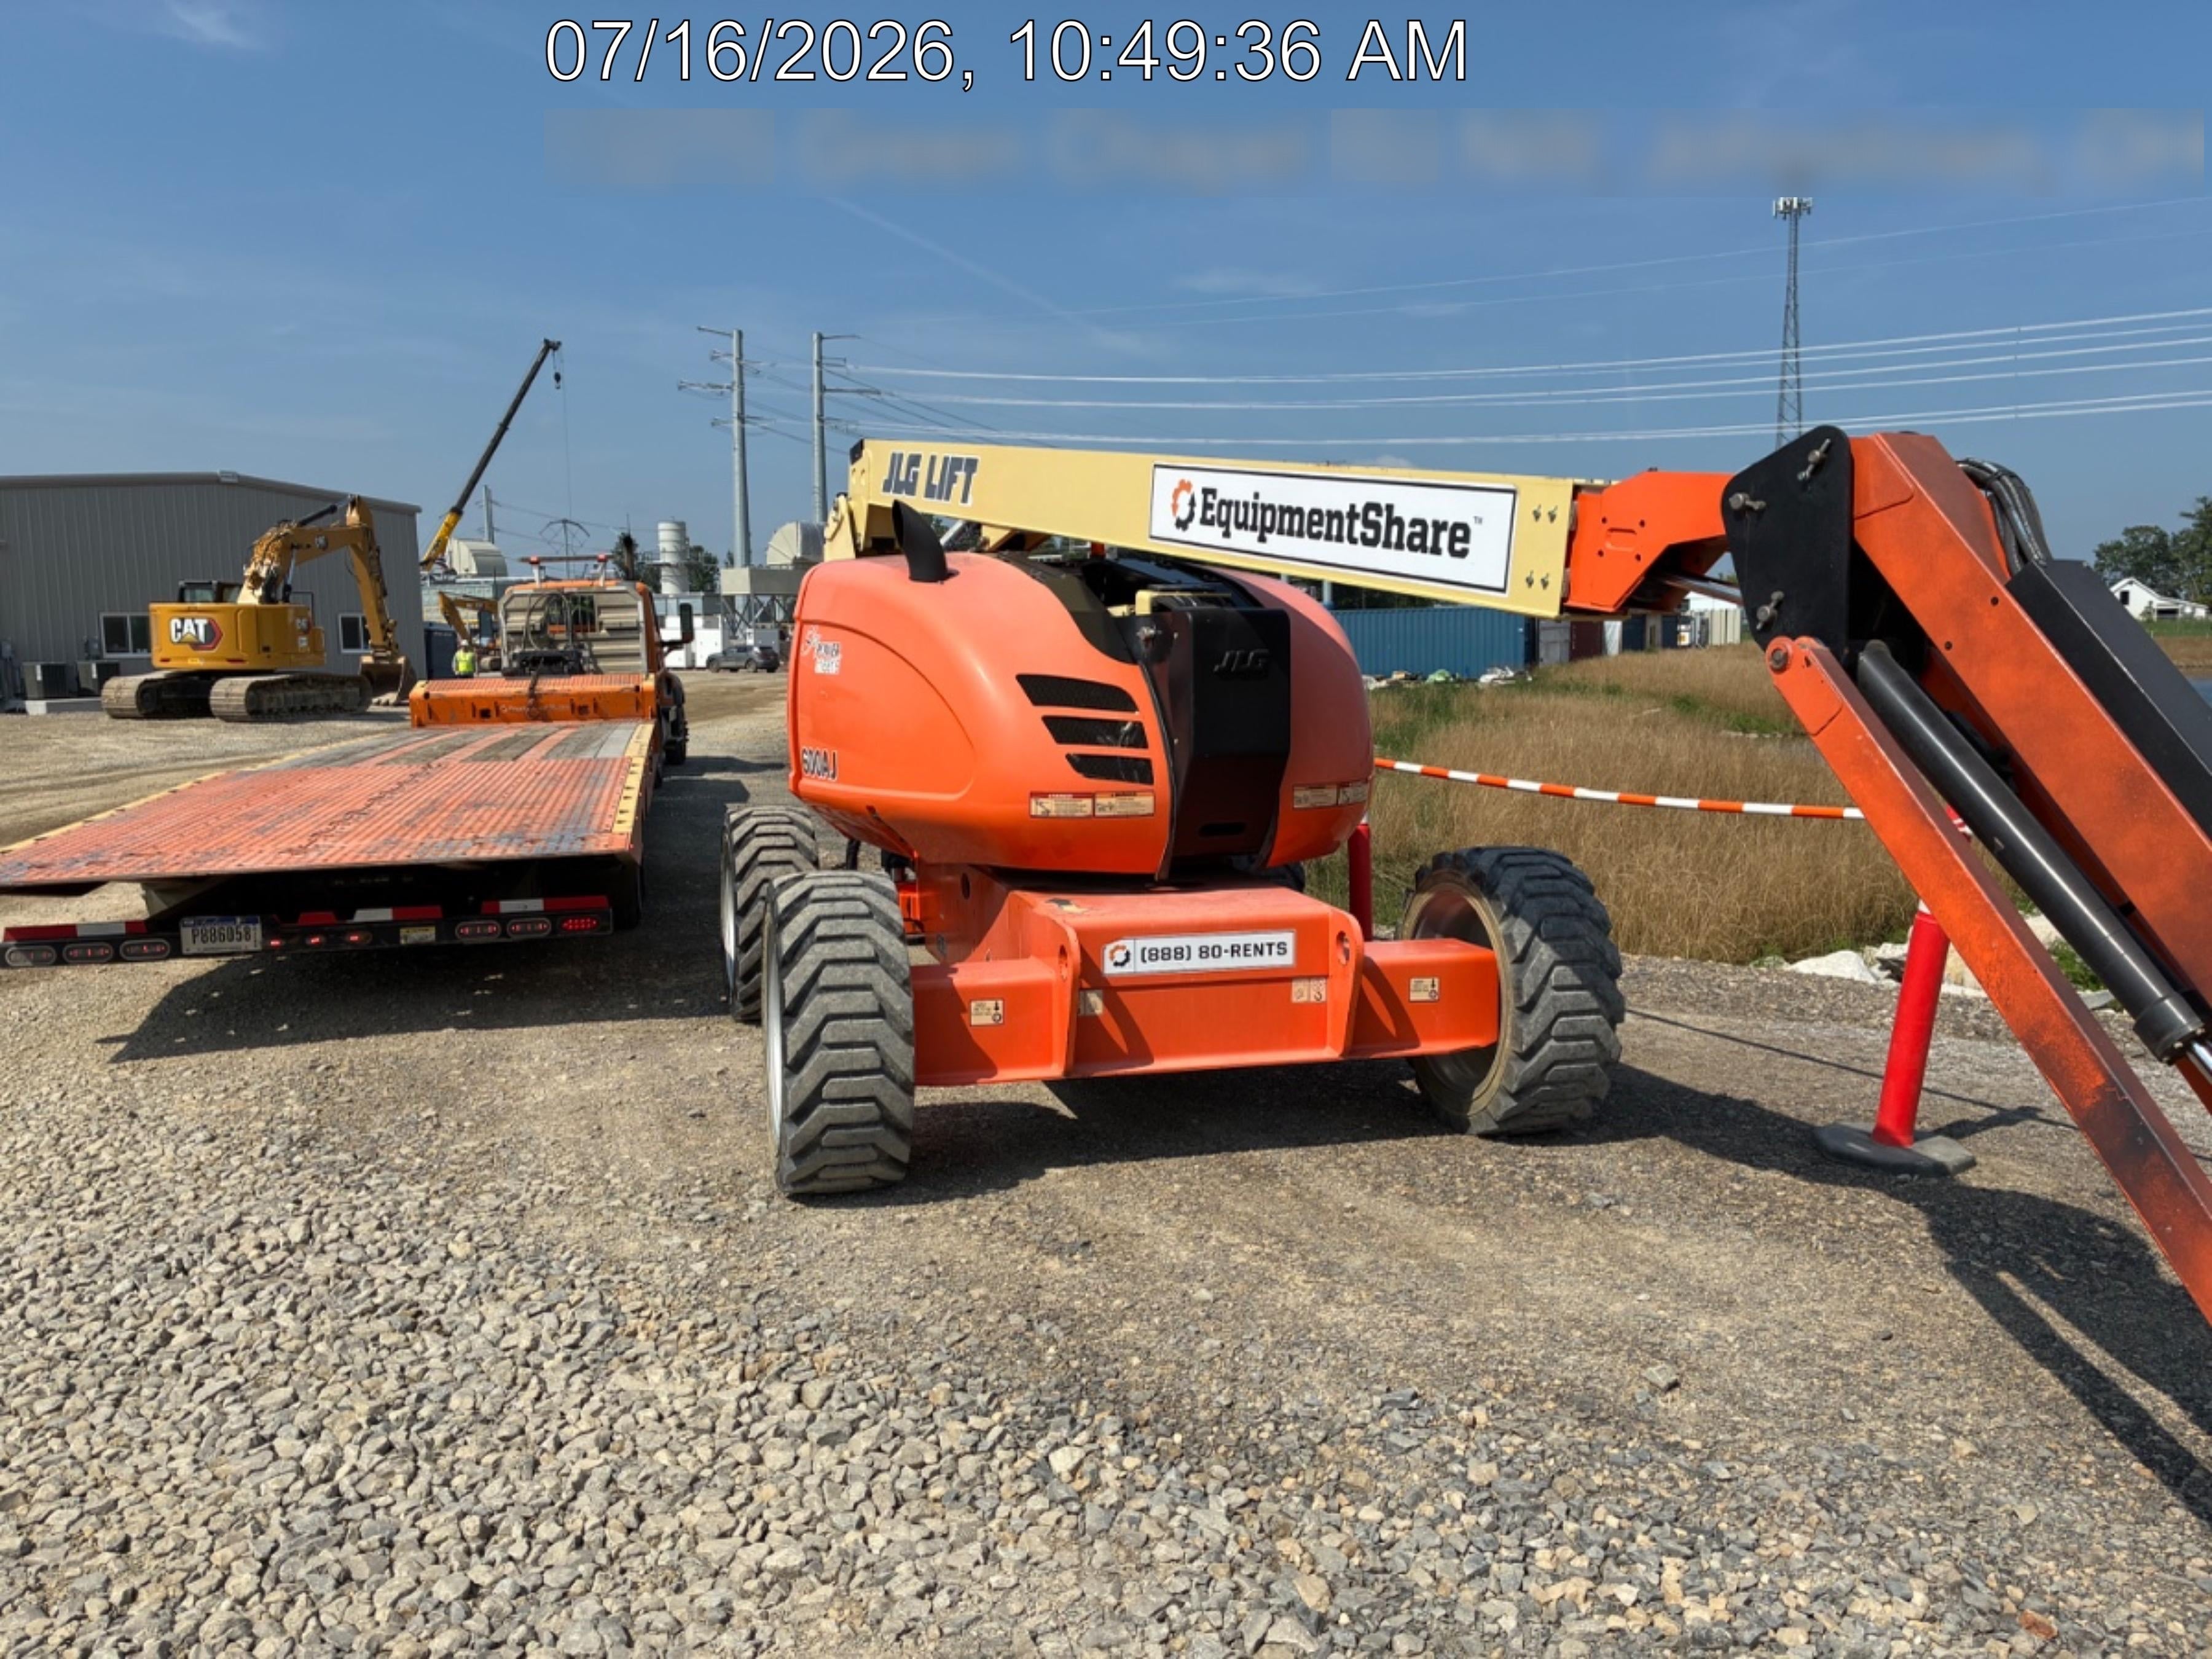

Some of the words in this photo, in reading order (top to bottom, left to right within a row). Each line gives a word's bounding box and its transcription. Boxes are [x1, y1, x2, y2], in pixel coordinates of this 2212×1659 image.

[882, 452, 922, 496] JLG
[924, 454, 979, 504] LIFT
[1199, 487, 1472, 559] EquipmentShare
[170, 618, 208, 644] CAT
[1213, 649, 1269, 673] JLG
[1140, 945, 1191, 963] (888)
[1198, 941, 1288, 959] 80-RENTS
